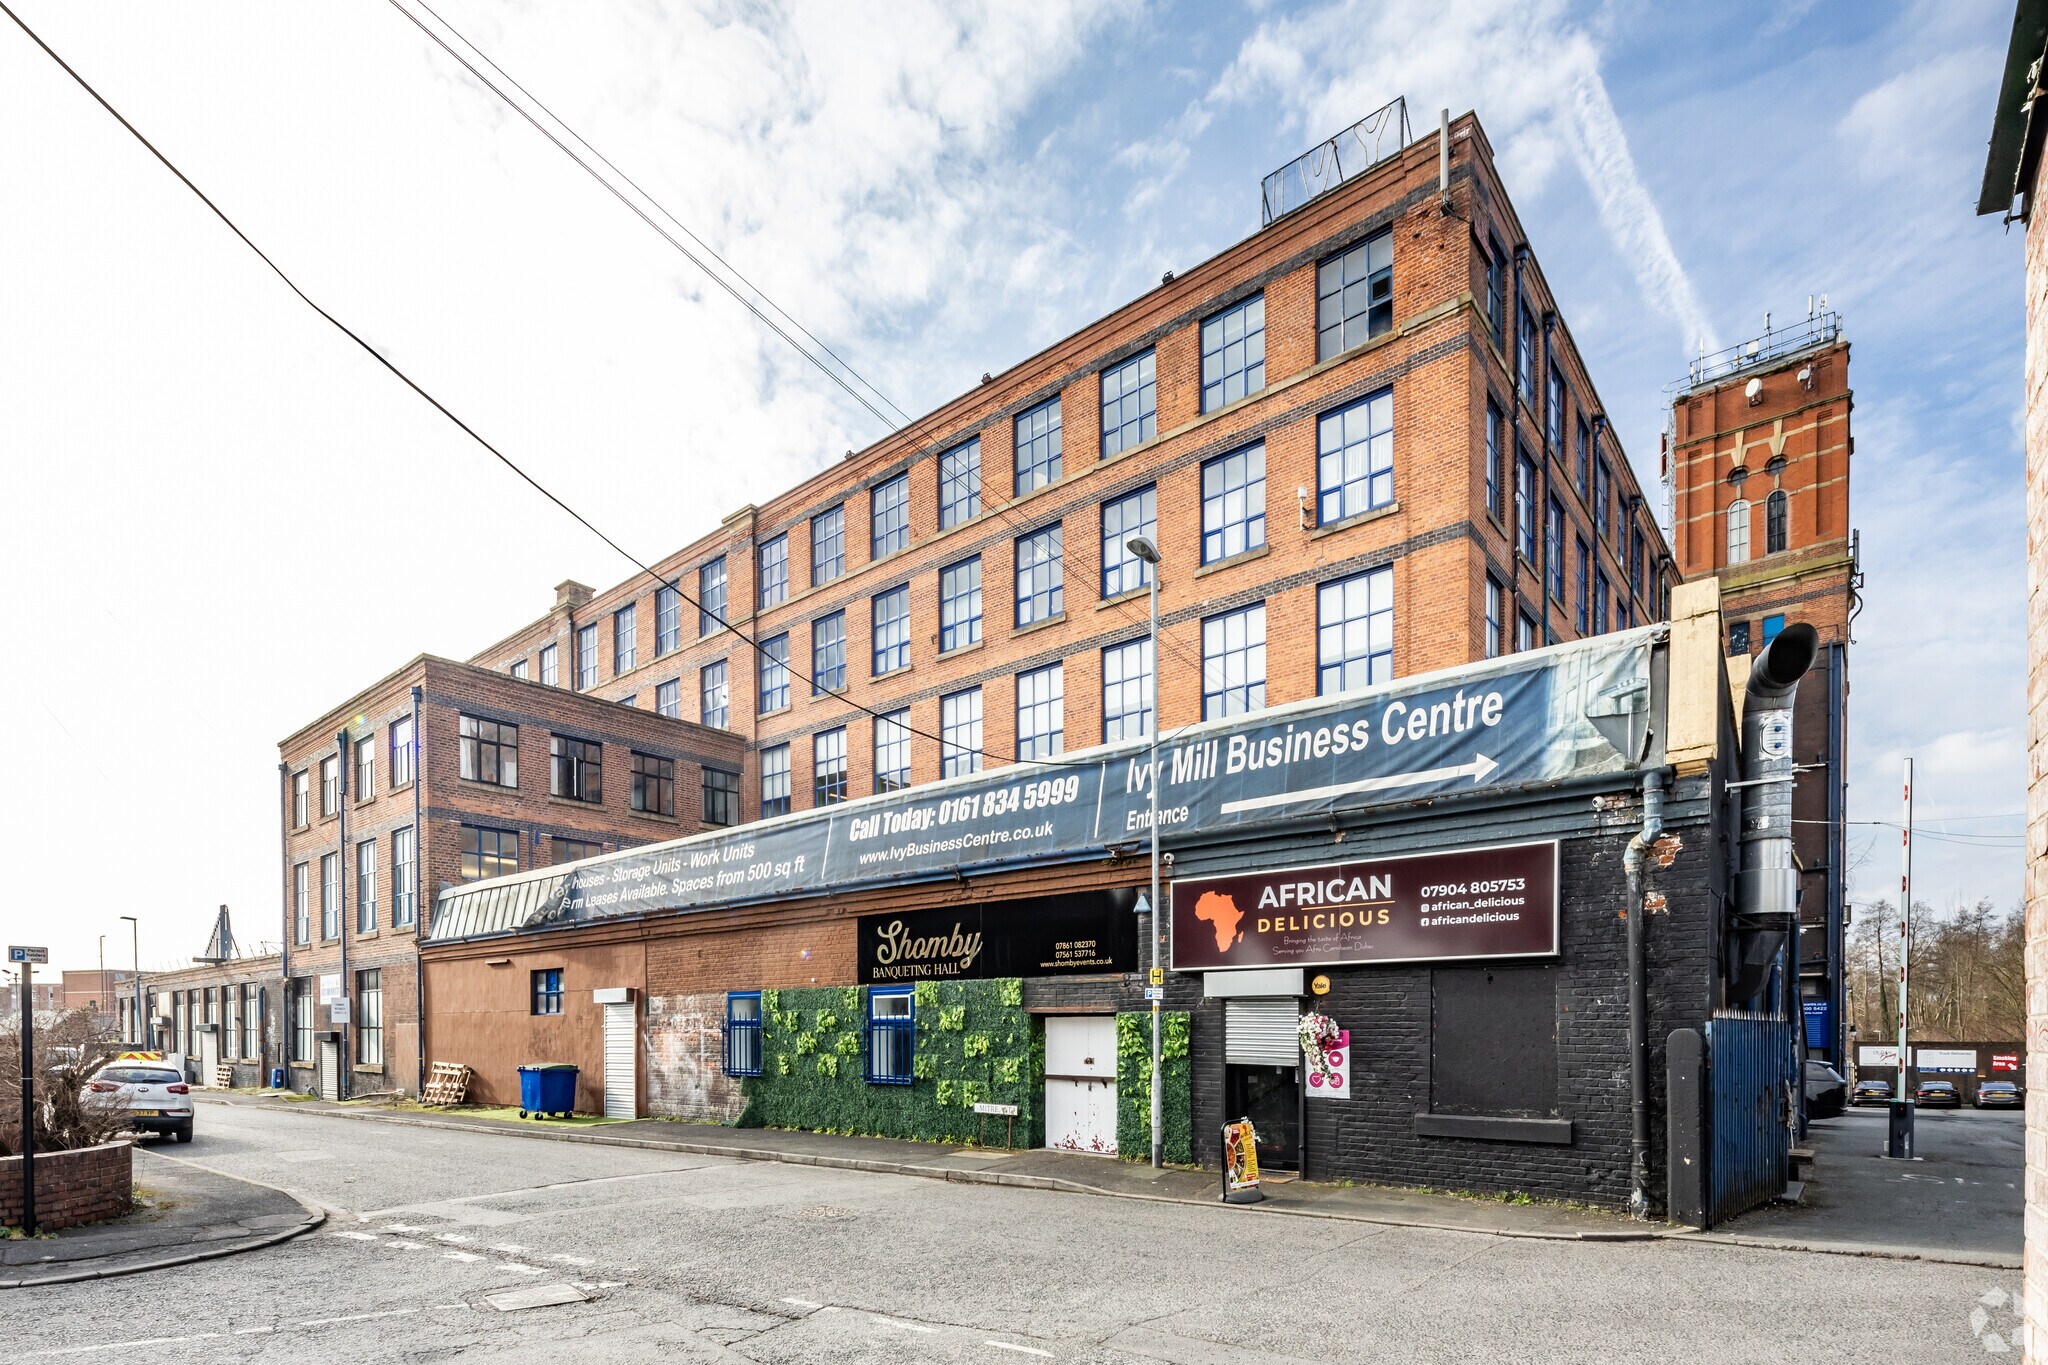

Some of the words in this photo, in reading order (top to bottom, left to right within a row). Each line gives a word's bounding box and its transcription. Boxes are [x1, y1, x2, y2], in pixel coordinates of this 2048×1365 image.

[1126, 758, 1164, 800] Ivy
[1170, 740, 1218, 785] Mill
[1226, 719, 1369, 775] Business
[1381, 689, 1504, 746] Centre
[850, 813, 880, 842] Call
[883, 806, 936, 835] Today:
[938, 794, 980, 825] 0161
[982, 786, 1020, 817] 834
[1024, 775, 1080, 810] 5999
[860, 821, 1053, 864] www.IvyBusinessCentre.co.uk
[612, 866, 651, 882] Storage
[653, 857, 680, 874] Units
[690, 848, 720, 868] Work
[722, 842, 755, 862] Units
[586, 892, 618, 907] Leases
[619, 881, 668, 902] Available.
[672, 875, 714, 896] Spaces
[716, 870, 744, 887] from
[748, 862, 772, 881] 500
[774, 861, 791, 878] sq
[794, 855, 806, 874] ft
[1421, 884, 1467, 898] 07904
[1470, 878, 1525, 894] 805753
[1258, 874, 1391, 909] AFRICAN
[1432, 897, 1524, 911] african_delicious
[1258, 910, 1390, 932] DELICIOUS
[1432, 912, 1519, 926] africandelicious
[877, 920, 983, 969] Shomby
[1074, 940, 1096, 948] 082370
[1284, 936, 1306, 945] Bringing
[1332, 932, 1338, 941] of
[1340, 932, 1362, 941] Africa
[14, 950, 23, 959] P
[1074, 950, 1096, 958] 537716
[1272, 946, 1294, 955] Serving
[1306, 945, 1321, 953] Afro
[1354, 942, 1374, 950] Dishes
[873, 964, 931, 979] BANQUETING
[934, 962, 960, 975] HALL
[1040, 957, 1112, 968] www.shombyevents.co.uk
[1152, 970, 1161, 983] H
